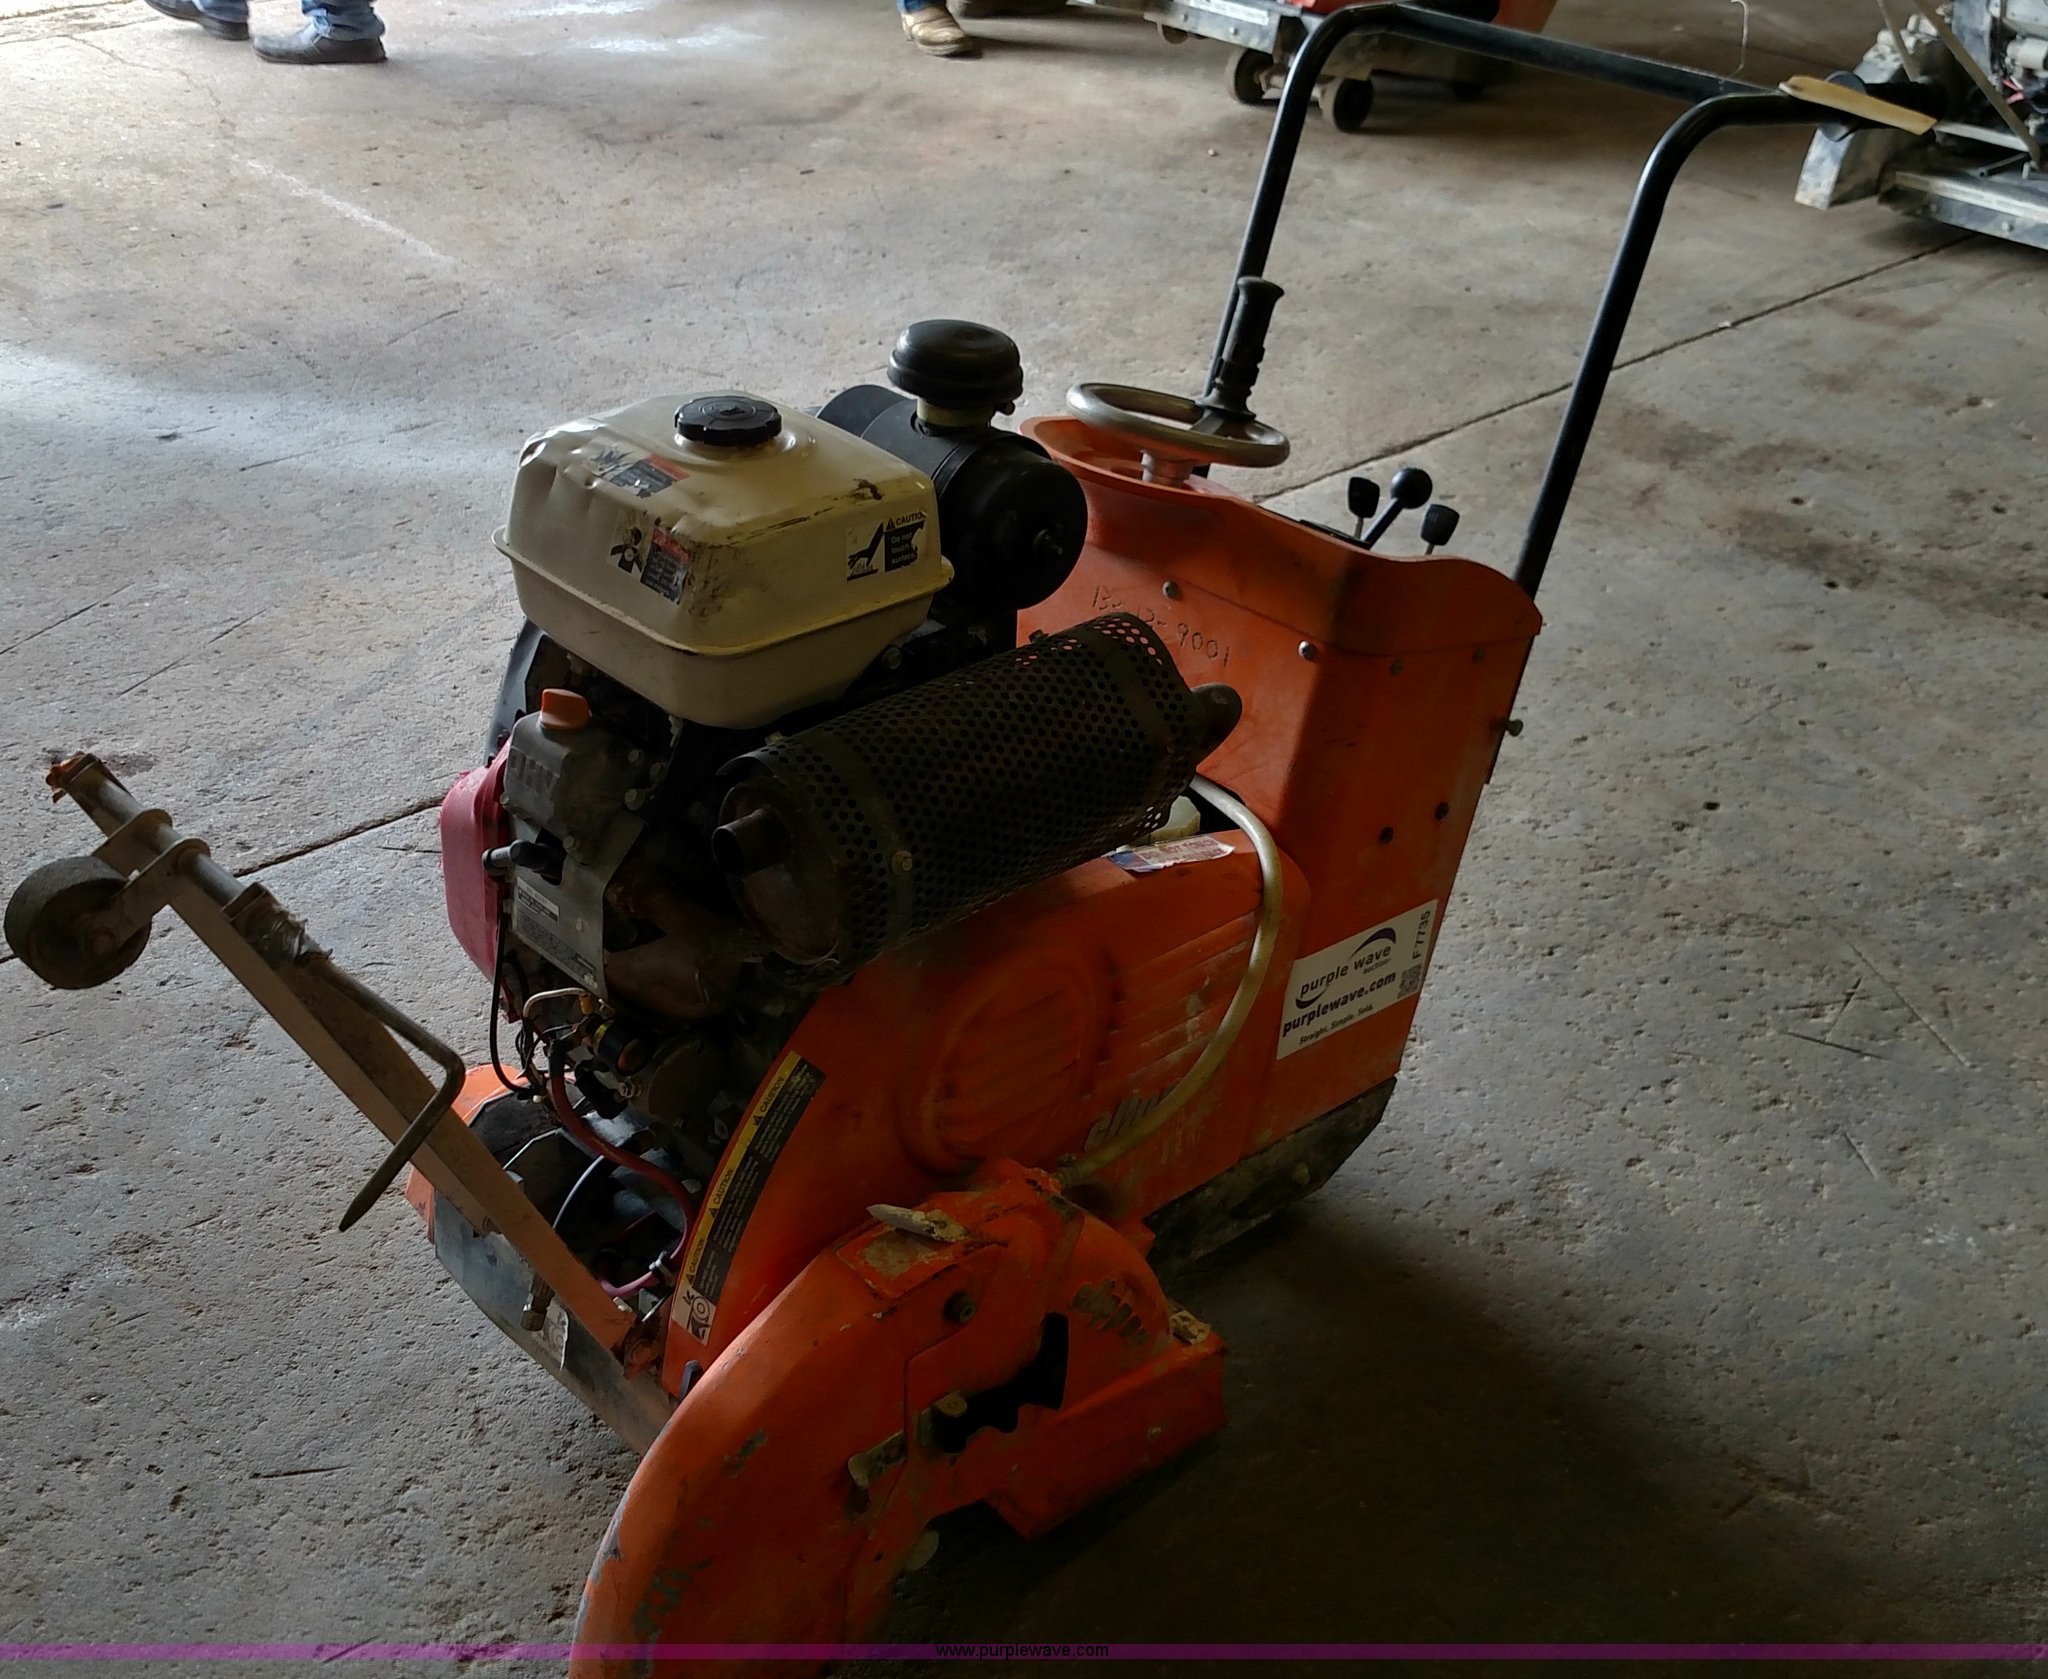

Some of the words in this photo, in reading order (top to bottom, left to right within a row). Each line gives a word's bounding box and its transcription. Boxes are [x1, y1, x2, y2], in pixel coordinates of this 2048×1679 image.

[1299, 965, 1348, 997] purple
[1353, 946, 1391, 970] wave
[1283, 972, 1396, 1037] purplewave.com
[760, 1076, 784, 1113] CAUTION
[712, 1168, 734, 1205] CAUTION
[689, 1238, 705, 1273] CAUTION
